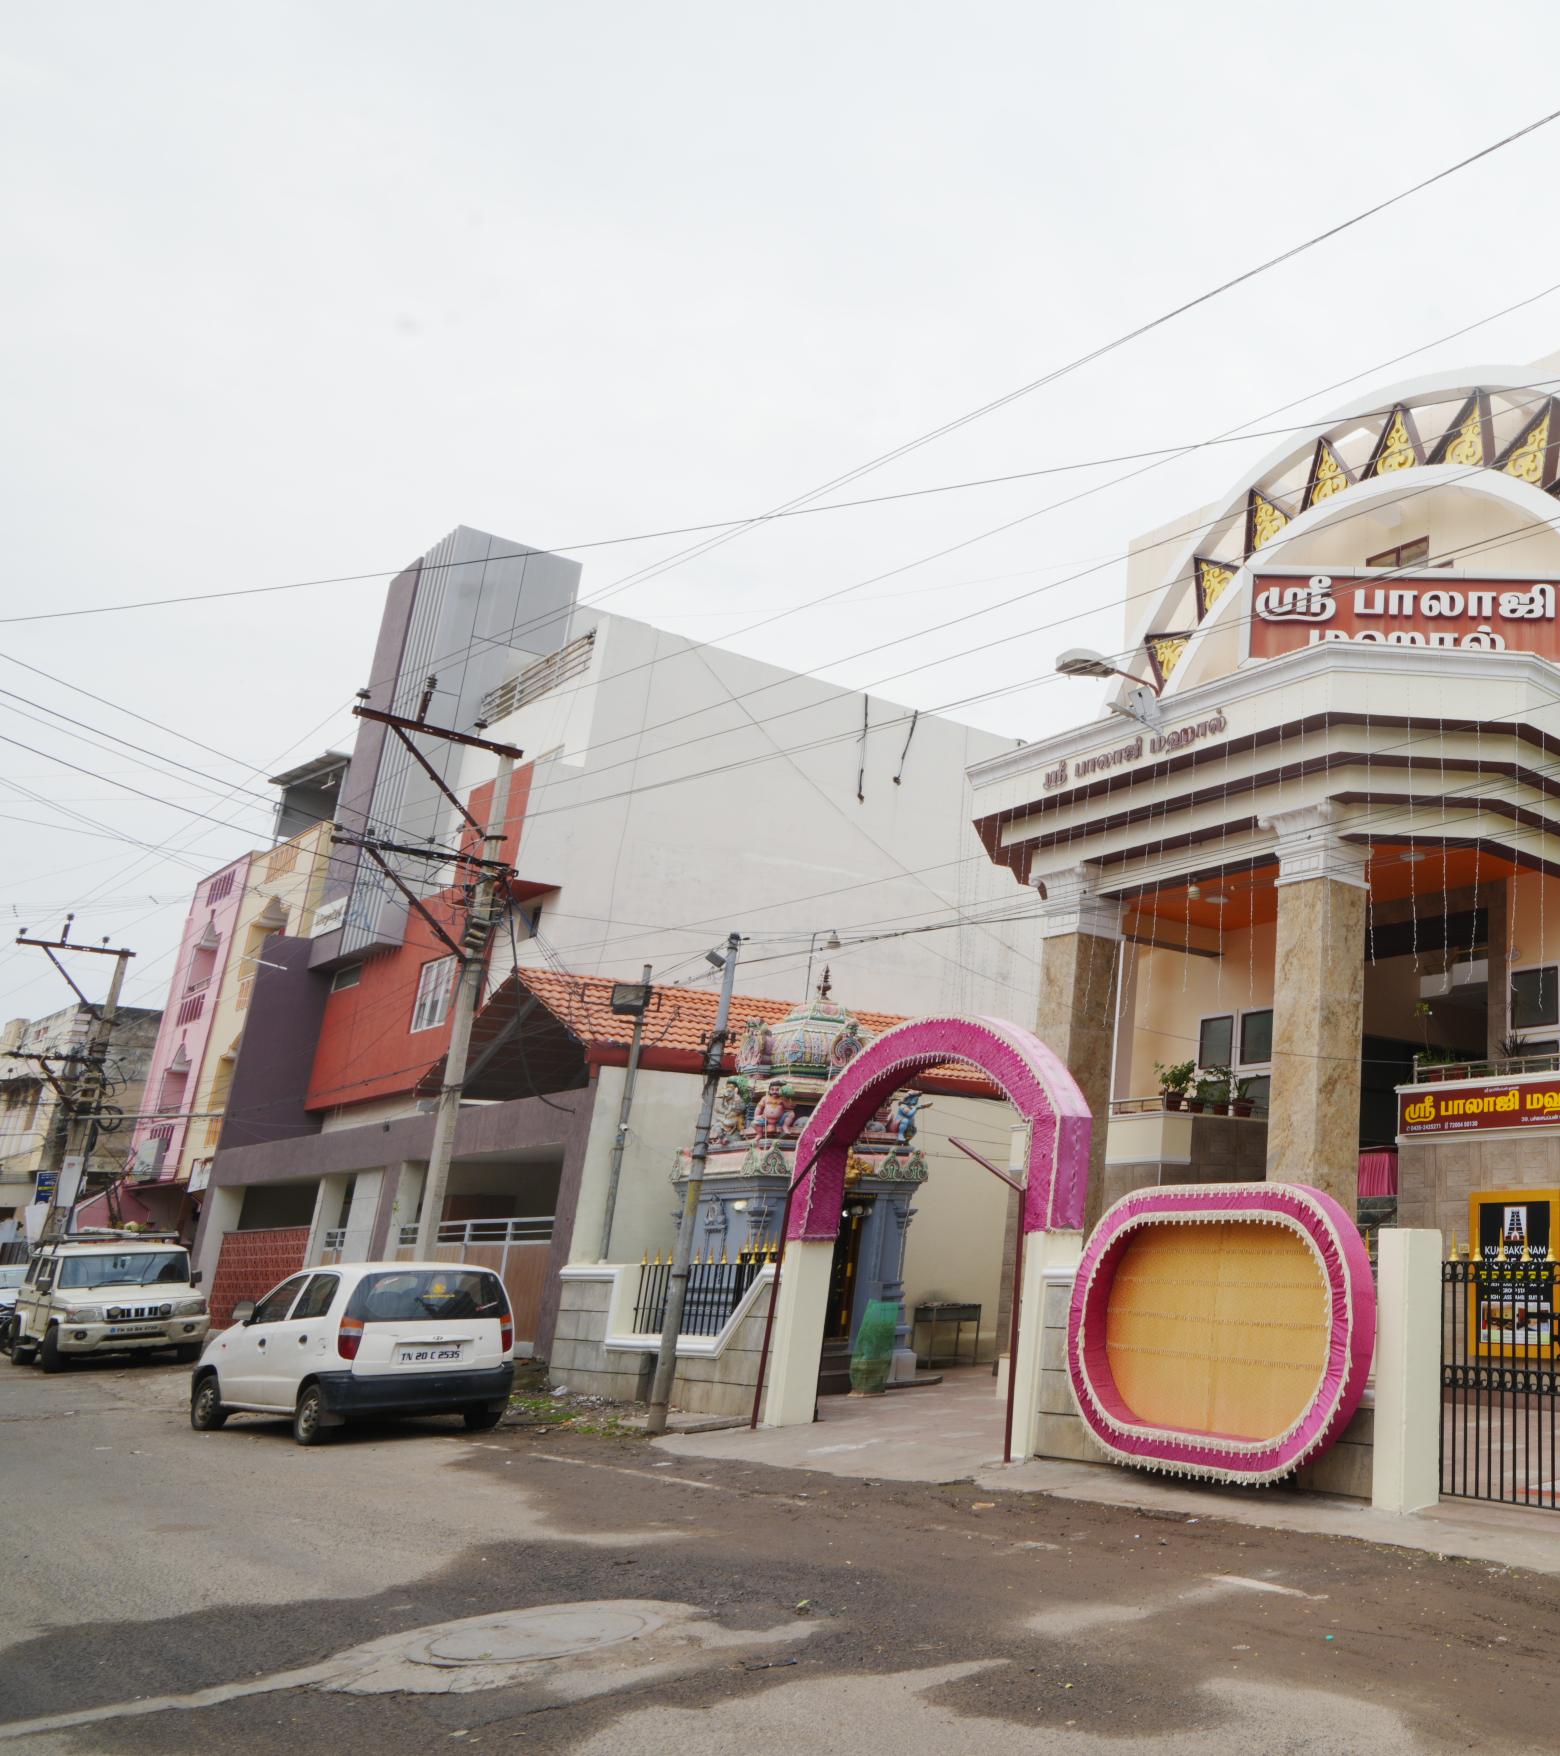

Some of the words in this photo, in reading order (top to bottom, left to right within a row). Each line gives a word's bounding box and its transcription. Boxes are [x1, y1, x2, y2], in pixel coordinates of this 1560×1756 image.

[1255, 576, 1337, 622] ஸ்ரீ
[1354, 584, 1557, 620] பாலாஜி
[1075, 735, 1144, 778] பாலாஜி
[1150, 708, 1228, 756] மஹால்
[1405, 1096, 1435, 1123] ஸ்ரீ
[1440, 1090, 1520, 1116] பாலாஜி
[402, 1352, 412, 1361] TN
[415, 1352, 428, 1360] 20
[430, 1351, 436, 1360] C
[438, 1350, 460, 1359] 2535
